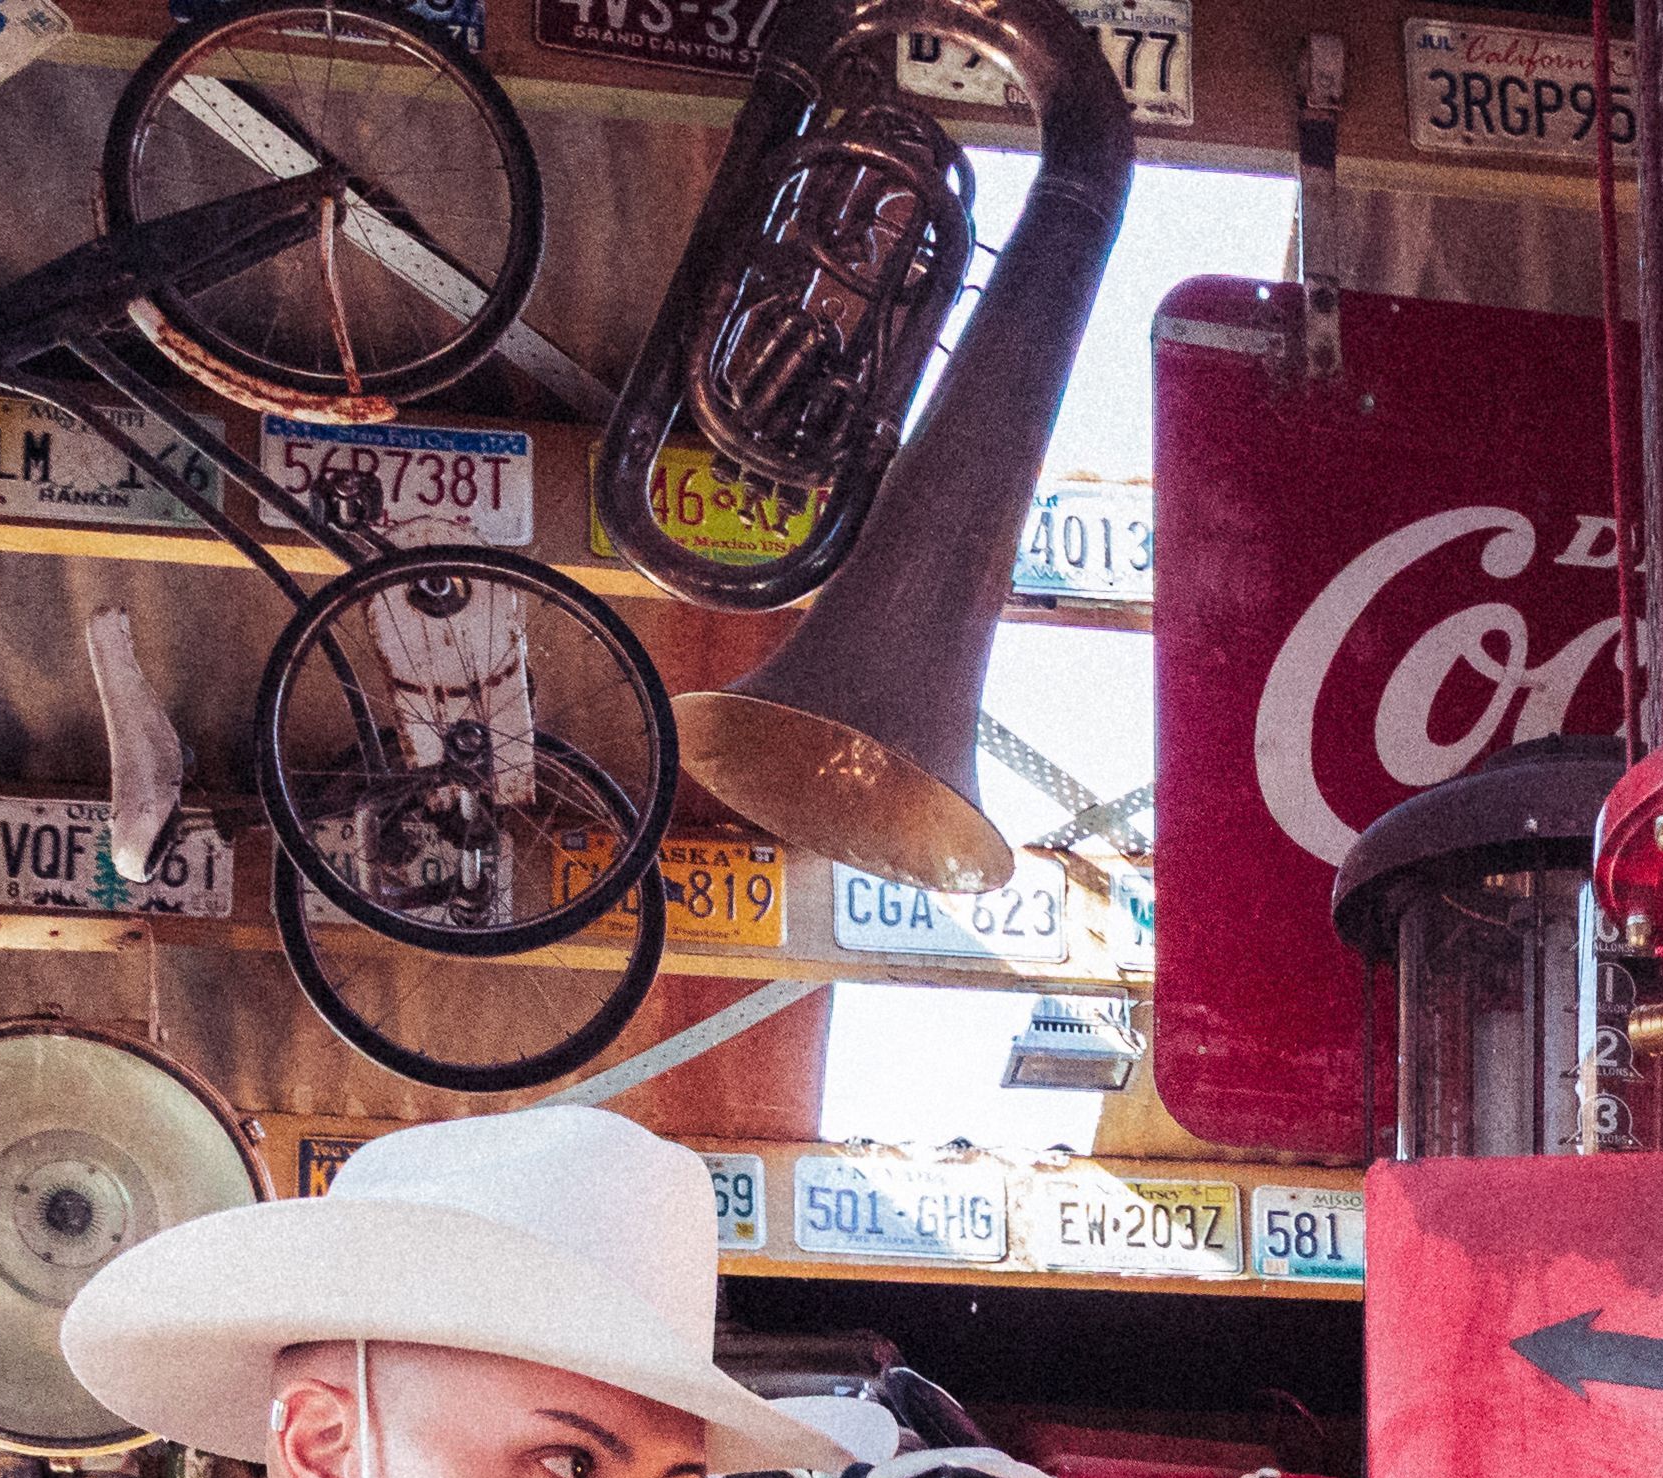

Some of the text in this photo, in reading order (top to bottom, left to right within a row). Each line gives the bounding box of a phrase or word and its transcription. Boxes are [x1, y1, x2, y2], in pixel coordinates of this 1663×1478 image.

[573, 26, 644, 48] GRAND
[648, 36, 734, 59] CANYON
[1418, 36, 1454, 51] JUL
[38, 486, 128, 508] RANKIN
[0, 819, 88, 880] VQF
[688, 871, 774, 922] 819
[847, 877, 1056, 937] CGA 623
[1595, 1030, 1619, 1068] 2
[1595, 1097, 1619, 1134] 3
[1267, 1210, 1342, 1261] 581
